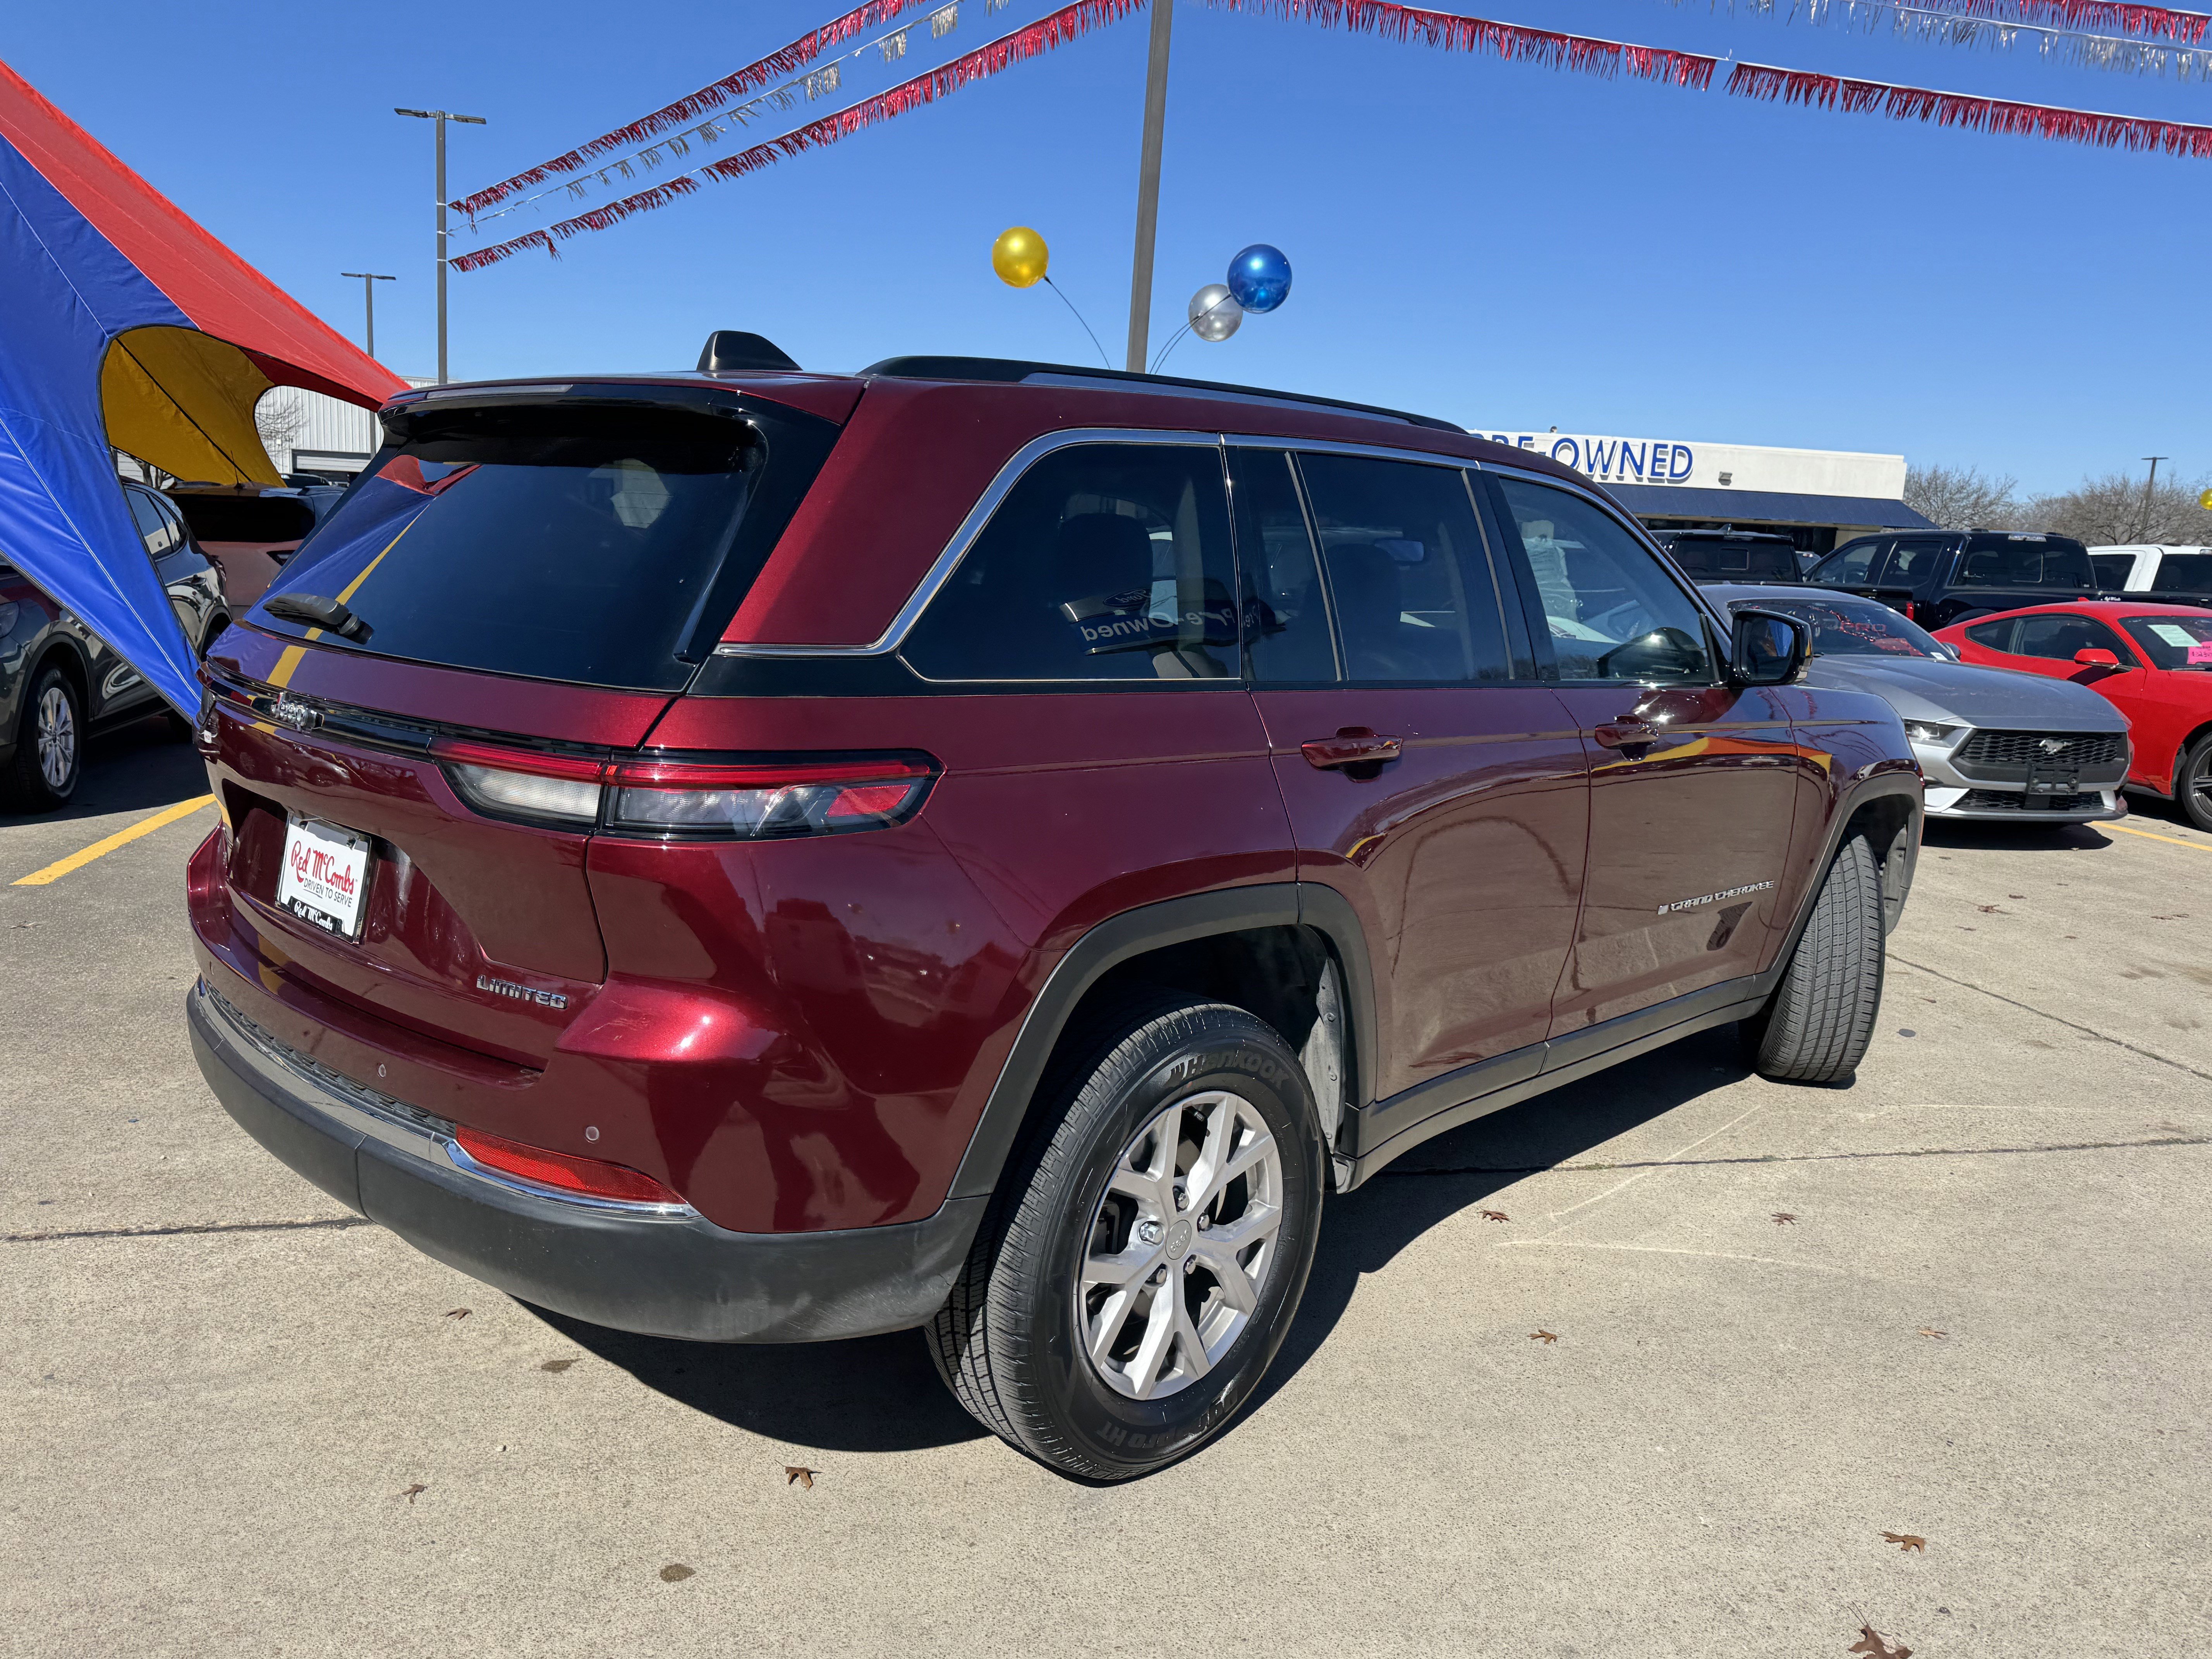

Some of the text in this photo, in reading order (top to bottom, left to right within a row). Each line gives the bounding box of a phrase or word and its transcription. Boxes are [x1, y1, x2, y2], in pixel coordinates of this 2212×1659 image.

[291, 840, 354, 895] Red McCombs
[304, 878, 352, 908] DRIVEN TO SERVE
[1670, 880, 1775, 911] GRAND CHEROKEE
[294, 901, 307, 918] Red
